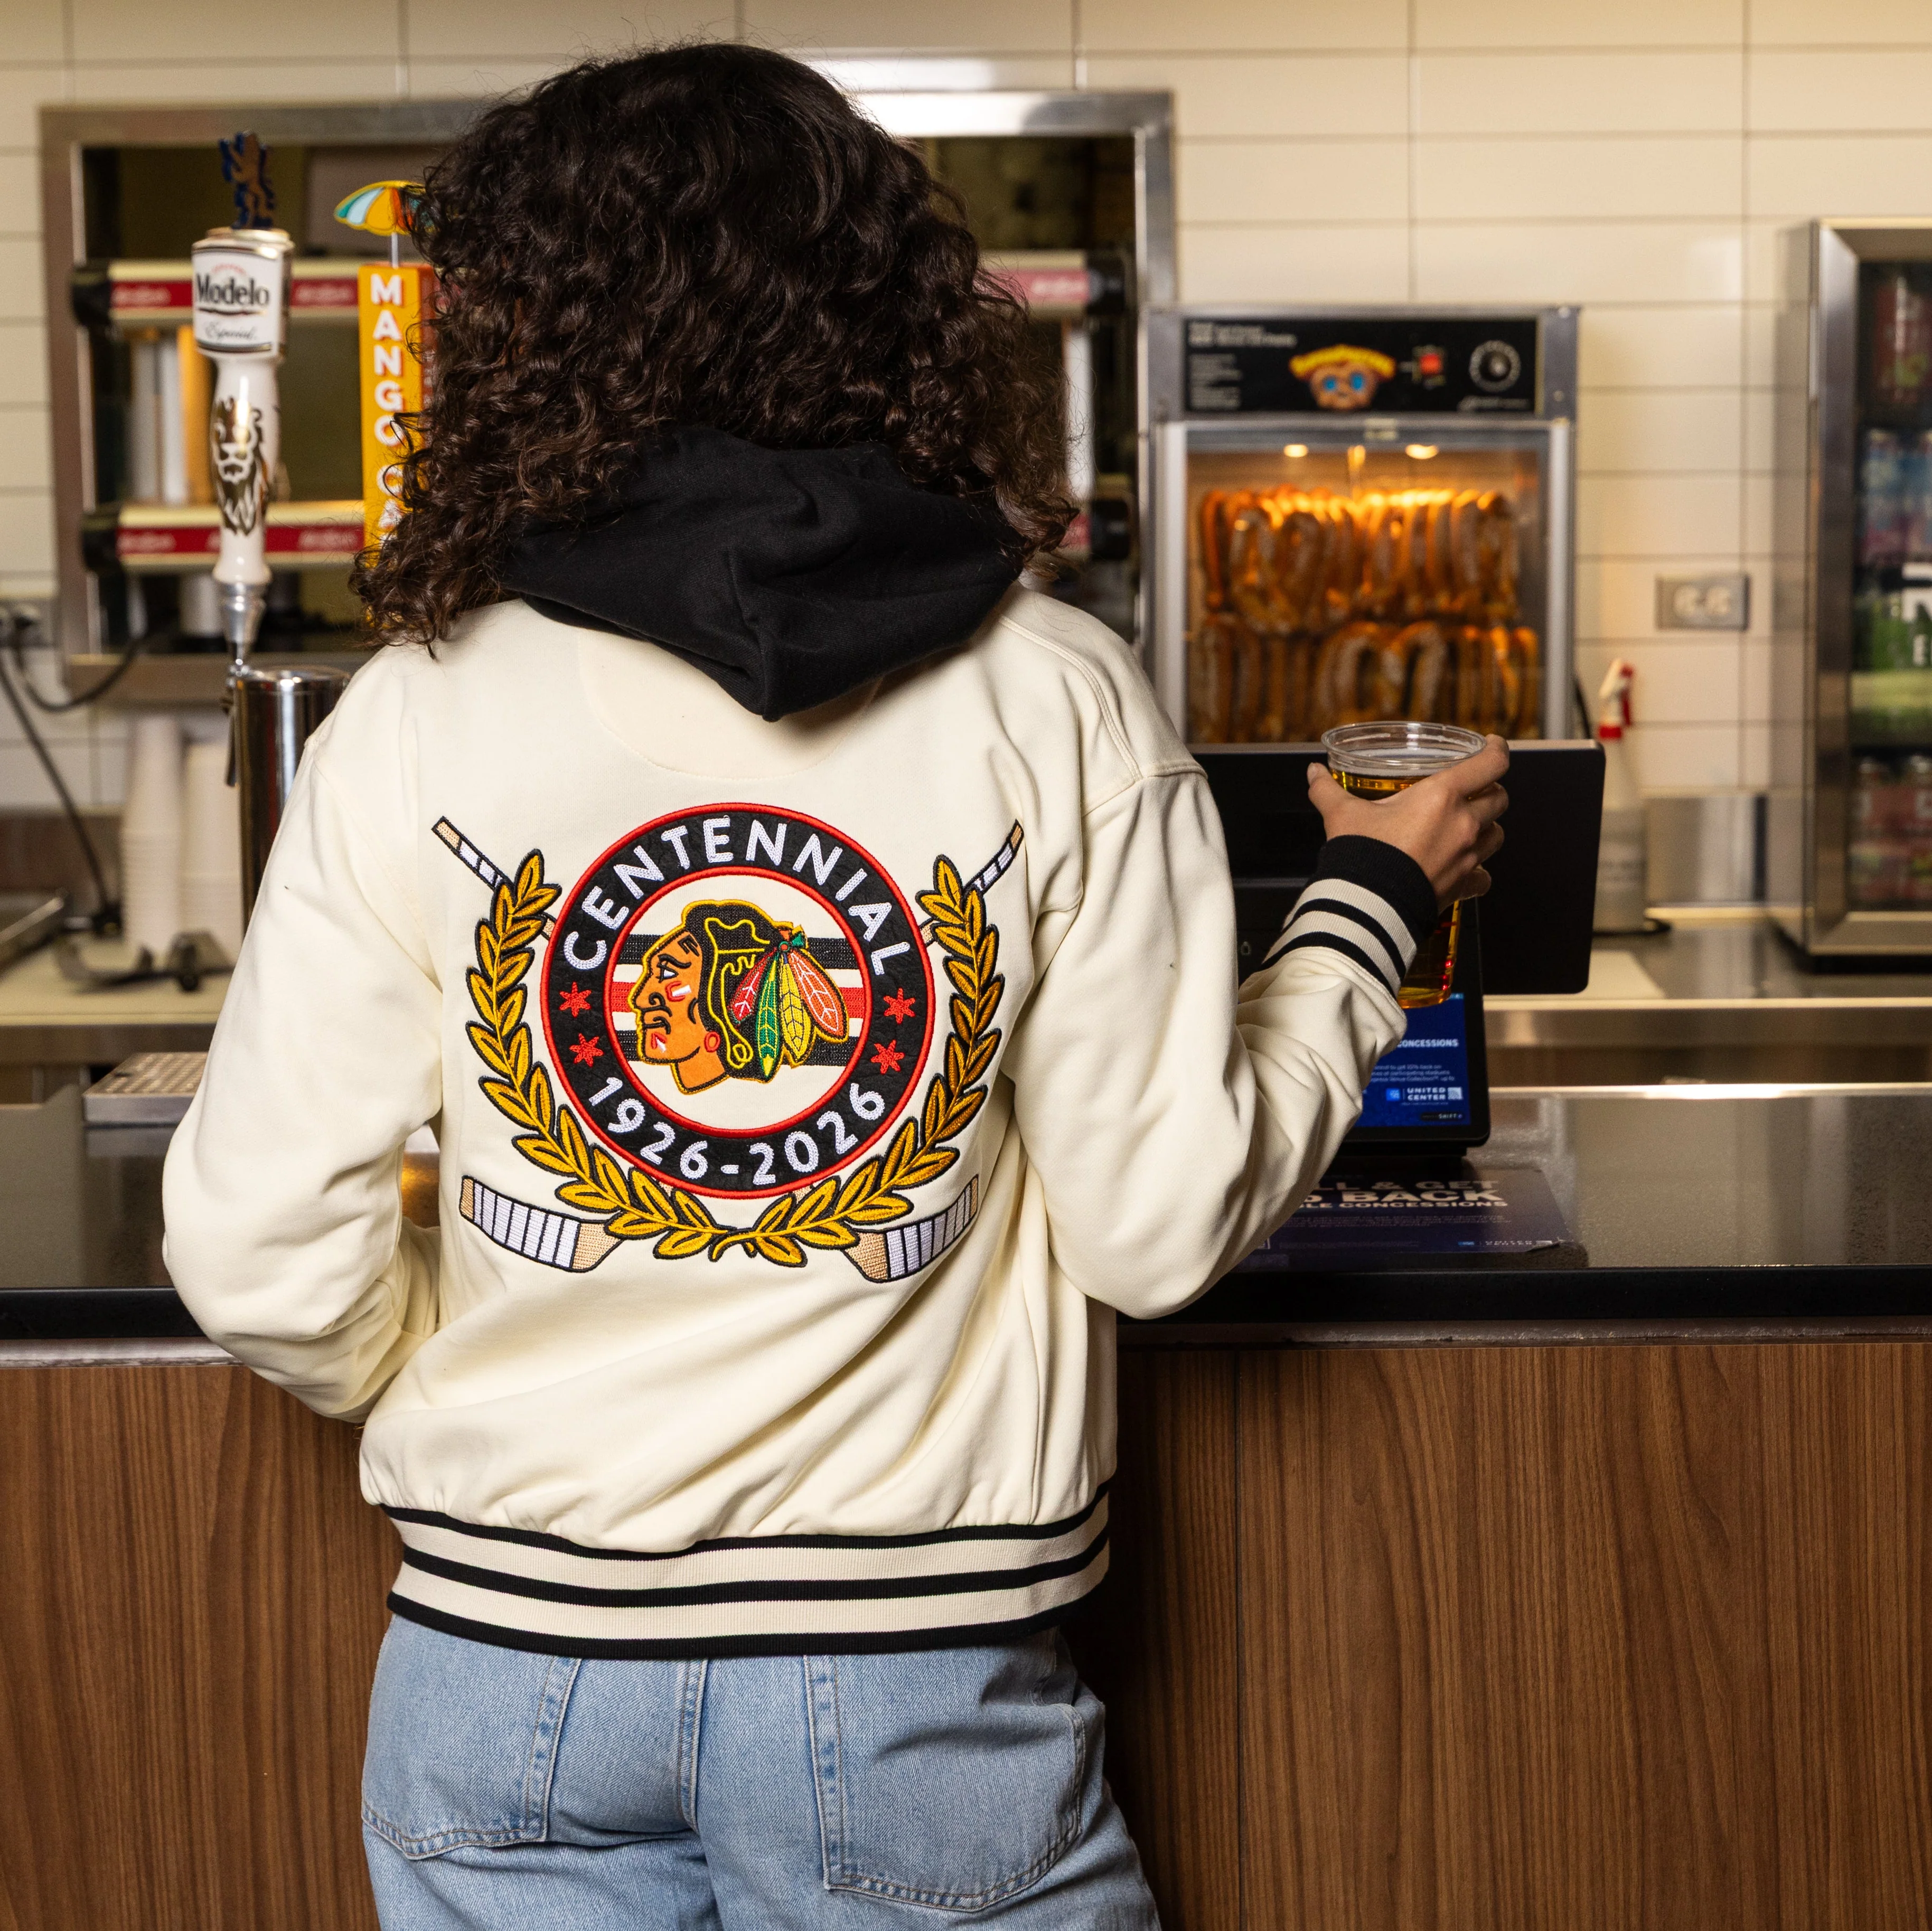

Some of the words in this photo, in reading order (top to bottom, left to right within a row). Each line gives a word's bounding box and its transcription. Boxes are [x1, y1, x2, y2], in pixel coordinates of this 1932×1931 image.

[197, 273, 269, 306] Modelo
[370, 273, 403, 446] MANGO
[564, 815, 911, 975] CENTENNIAL
[588, 1077, 885, 1185] 1926-2026
[1342, 1190, 1504, 1202] BACK
[1415, 1181, 1498, 1189] GET
